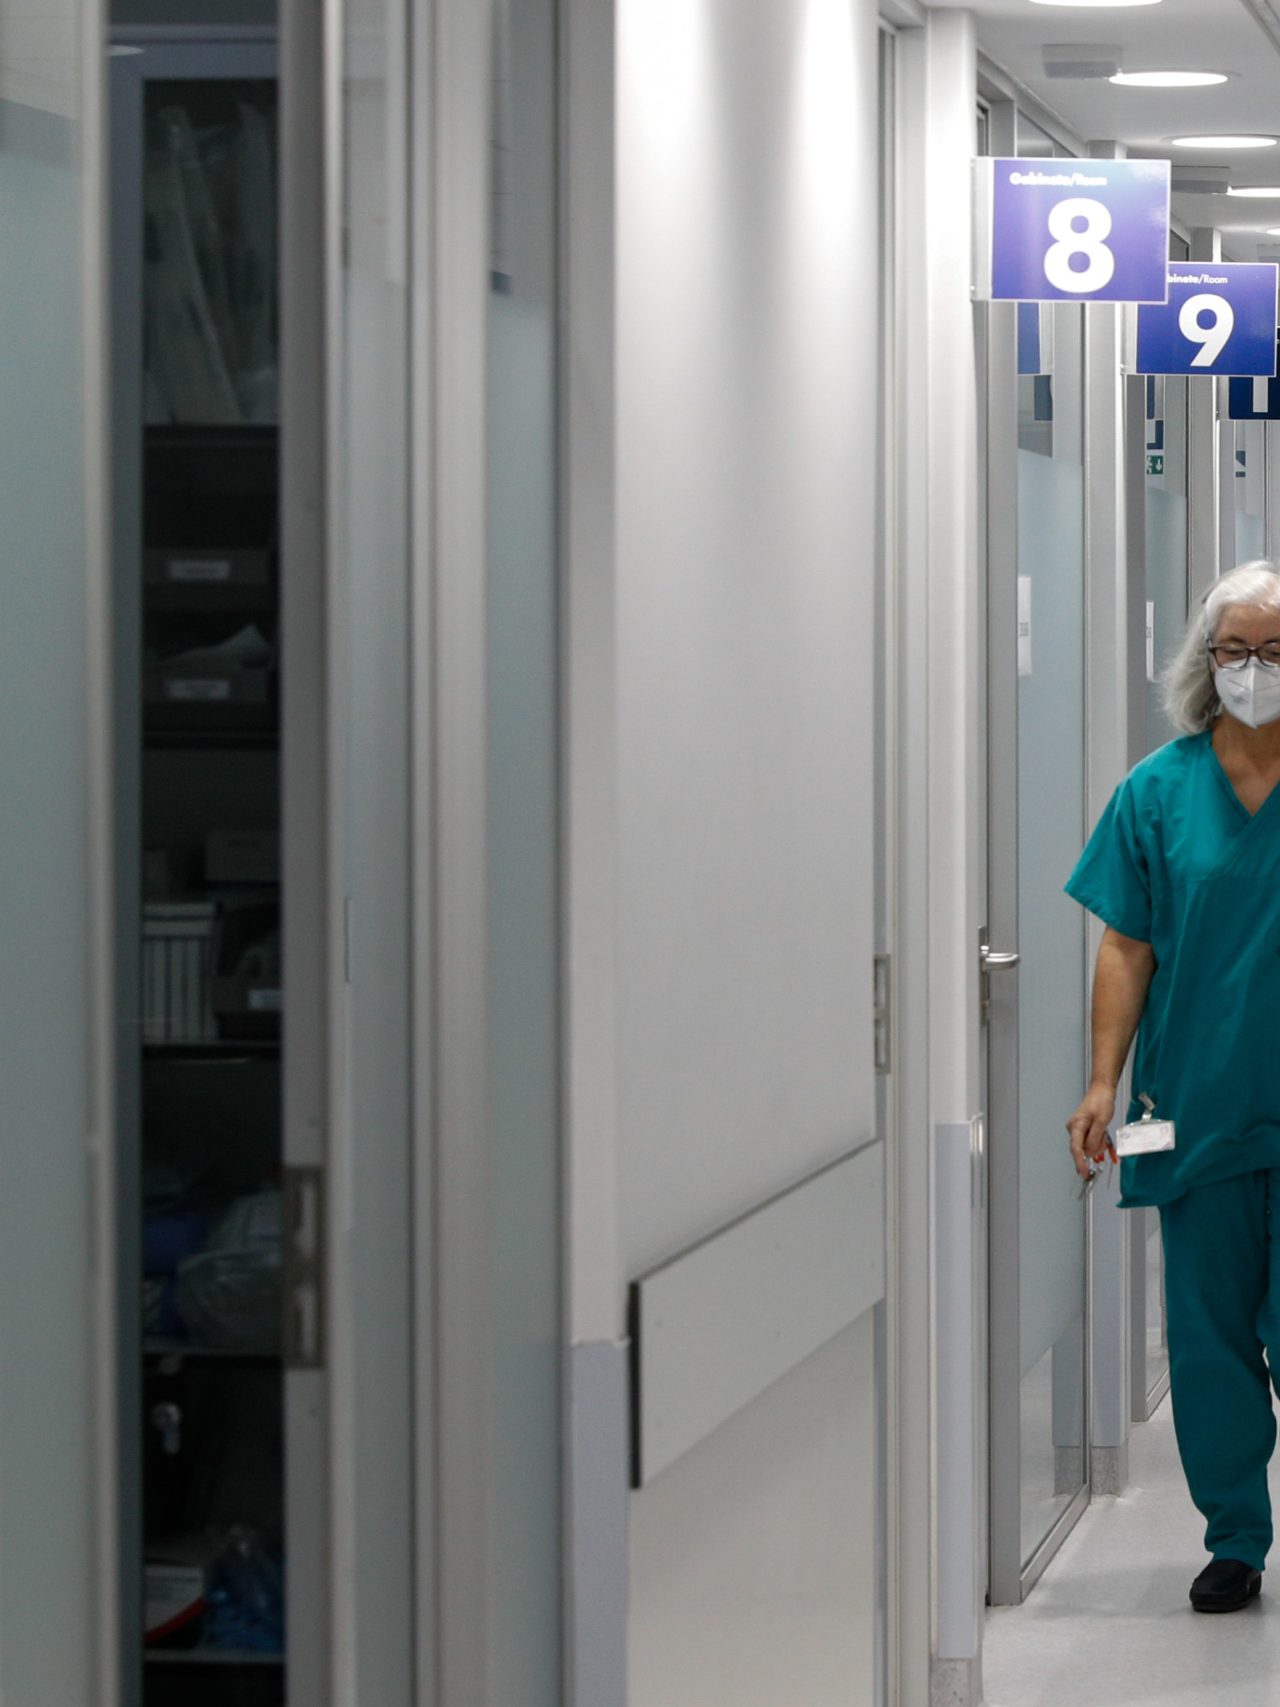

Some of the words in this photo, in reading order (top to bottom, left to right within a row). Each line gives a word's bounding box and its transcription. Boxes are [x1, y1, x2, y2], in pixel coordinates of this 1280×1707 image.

[1043, 197, 1115, 293] 8
[1167, 273, 1228, 284] binete/Room
[1178, 293, 1235, 367] 9
